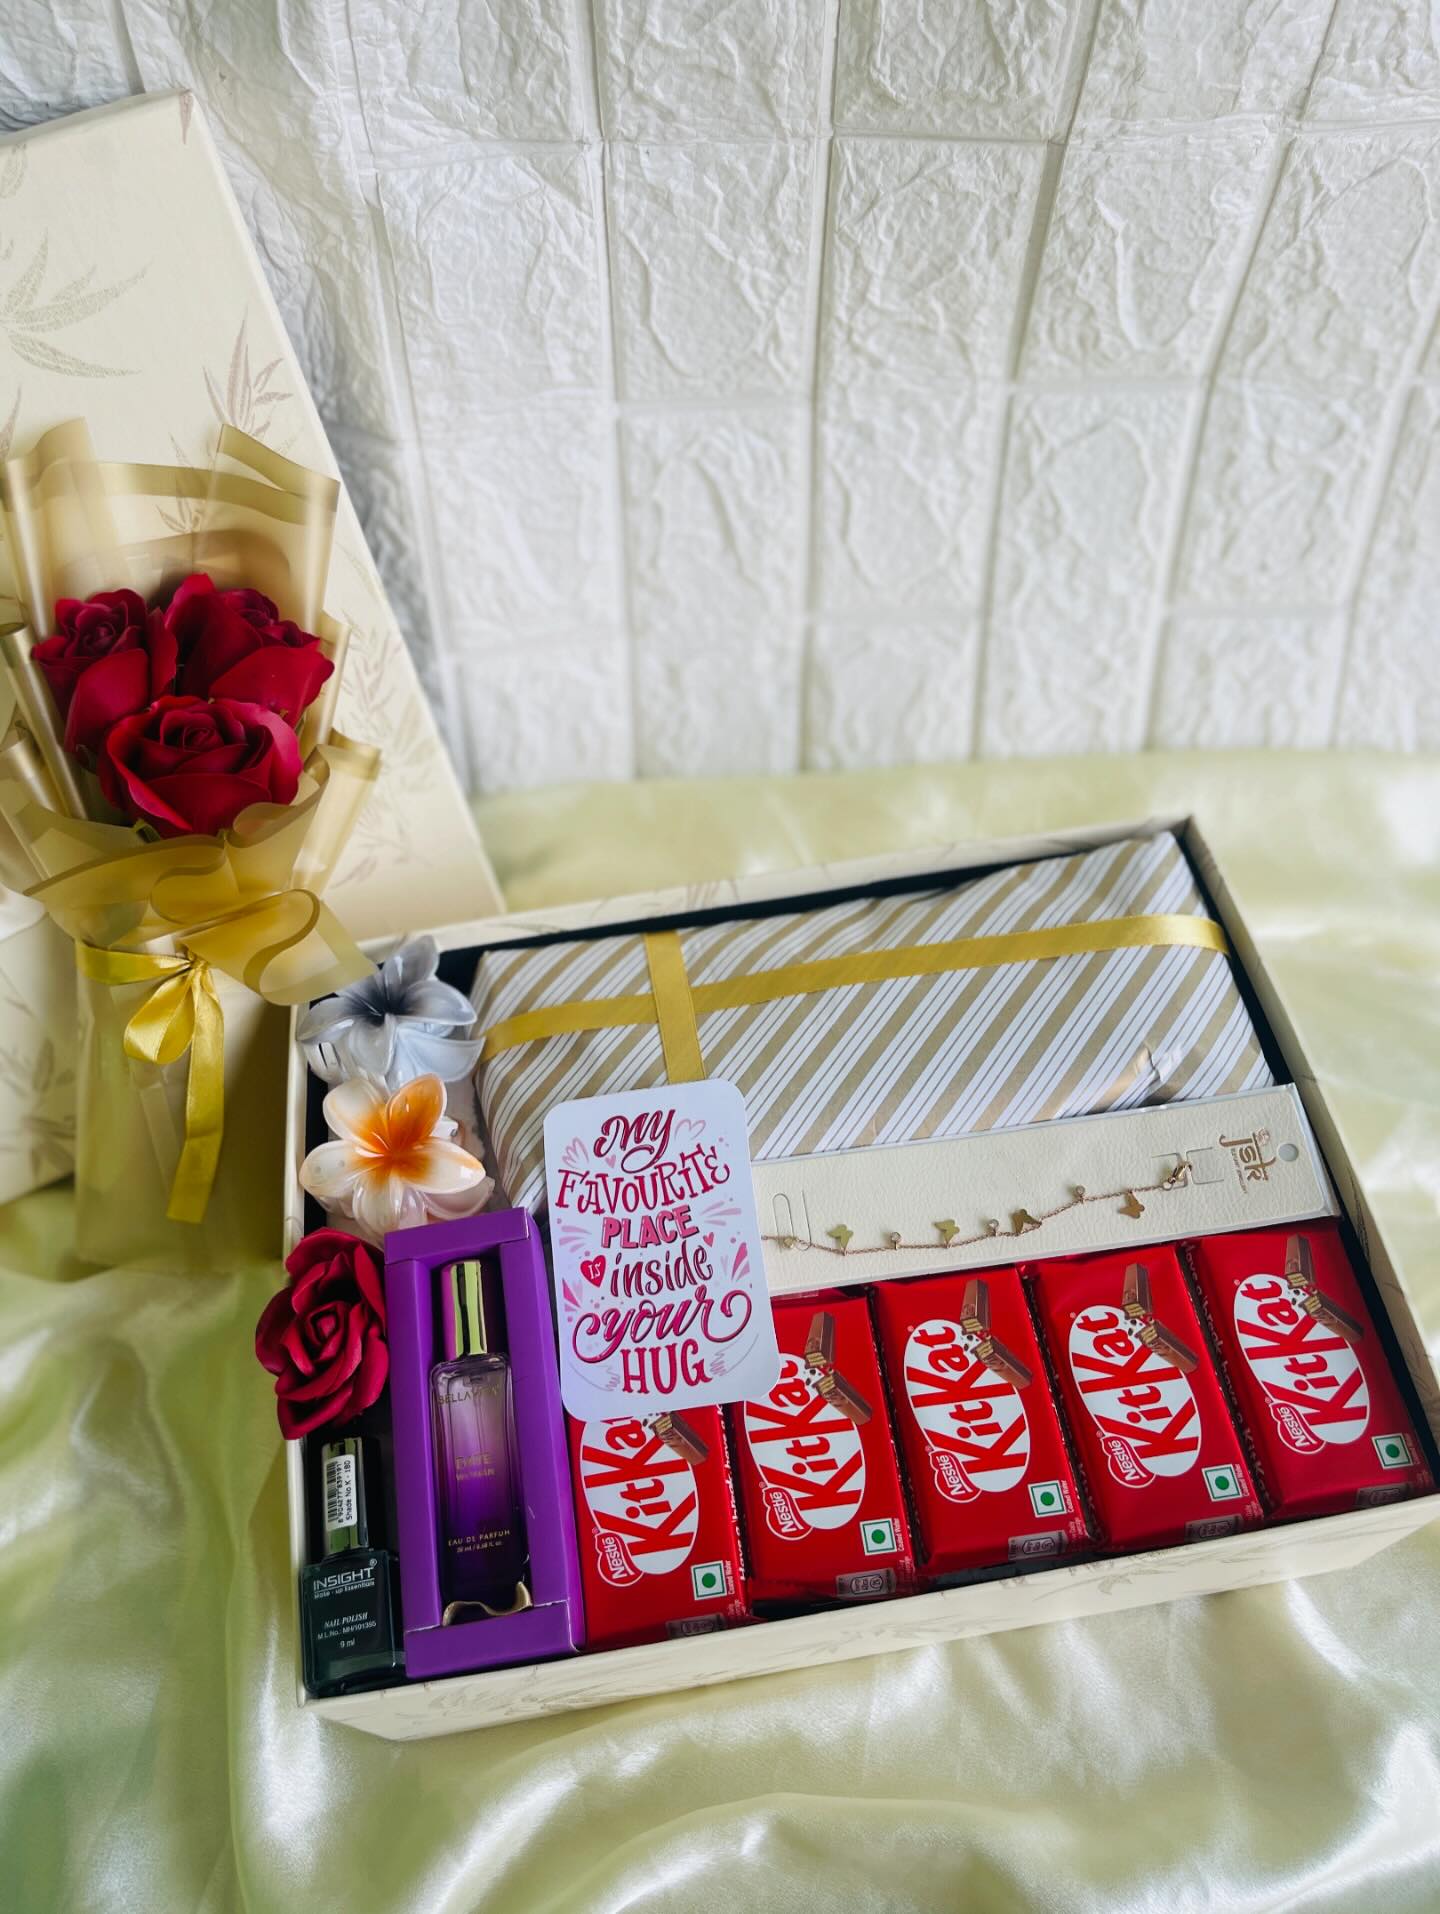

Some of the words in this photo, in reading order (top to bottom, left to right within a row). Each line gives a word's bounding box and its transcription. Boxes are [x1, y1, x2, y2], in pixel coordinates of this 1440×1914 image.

[600, 1204, 700, 1249] PLACE
[610, 1239, 714, 1298] inside
[572, 1285, 752, 1364] your
[621, 1338, 713, 1395] HUG
[581, 1416, 697, 1557] KitKa
[313, 1566, 375, 1592] INSIGHT
[324, 1617, 341, 1629] NAIL
[342, 1611, 369, 1625] POLISH
